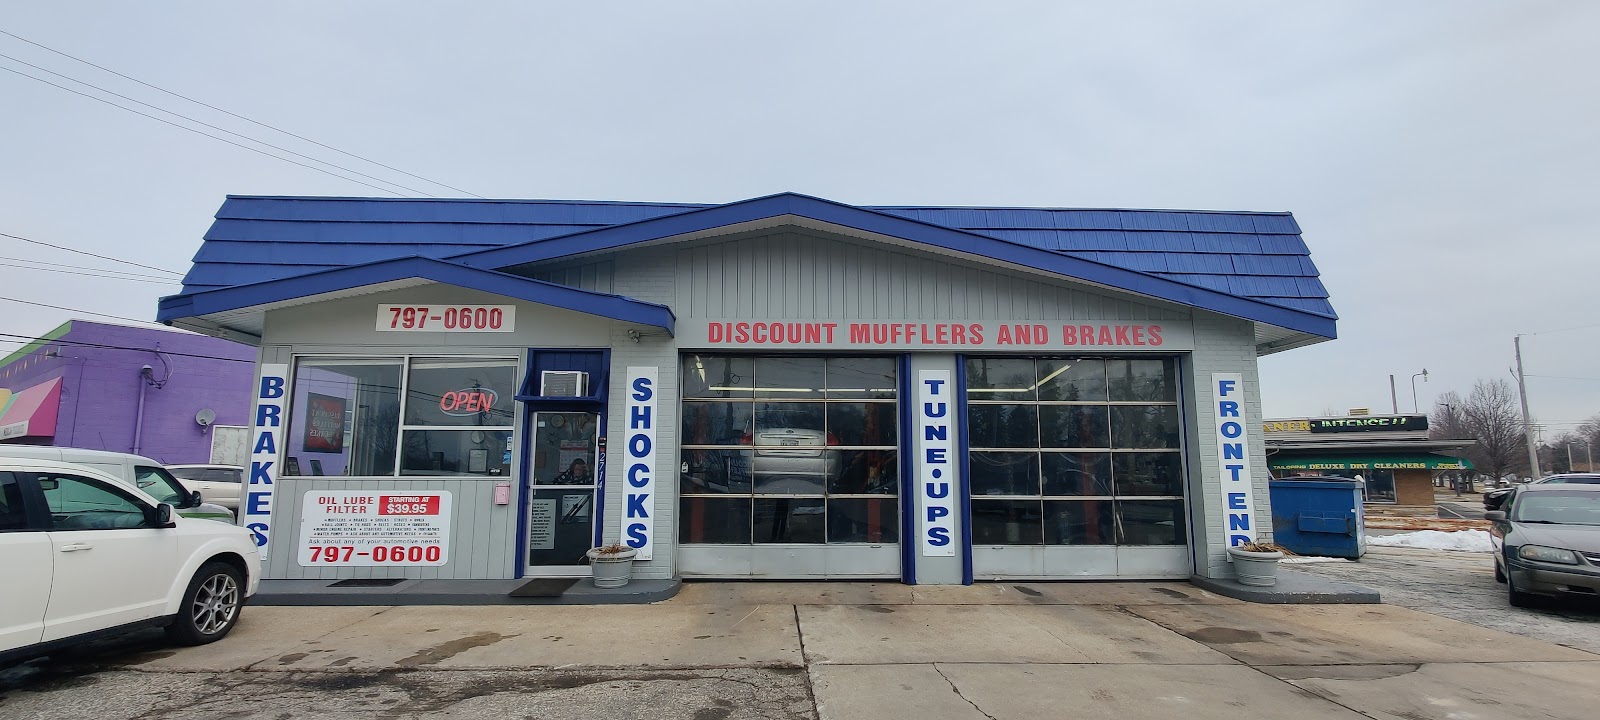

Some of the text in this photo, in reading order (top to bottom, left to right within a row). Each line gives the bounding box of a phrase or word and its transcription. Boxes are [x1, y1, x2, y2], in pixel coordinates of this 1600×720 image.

[389, 307, 503, 329] 797-0600
[708, 322, 1163, 346] DISCOUNT MUFFLERS AND BRAKES
[440, 391, 494, 412] OPEN
[246, 376, 284, 547] BRAKES
[626, 377, 653, 549] SHOCKS
[1218, 380, 1251, 547] FRONT END
[318, 496, 374, 505] OIL LUBE
[326, 505, 367, 513] FILTER
[387, 503, 427, 514] $39.95
[309, 546, 441, 562] 797-0600
